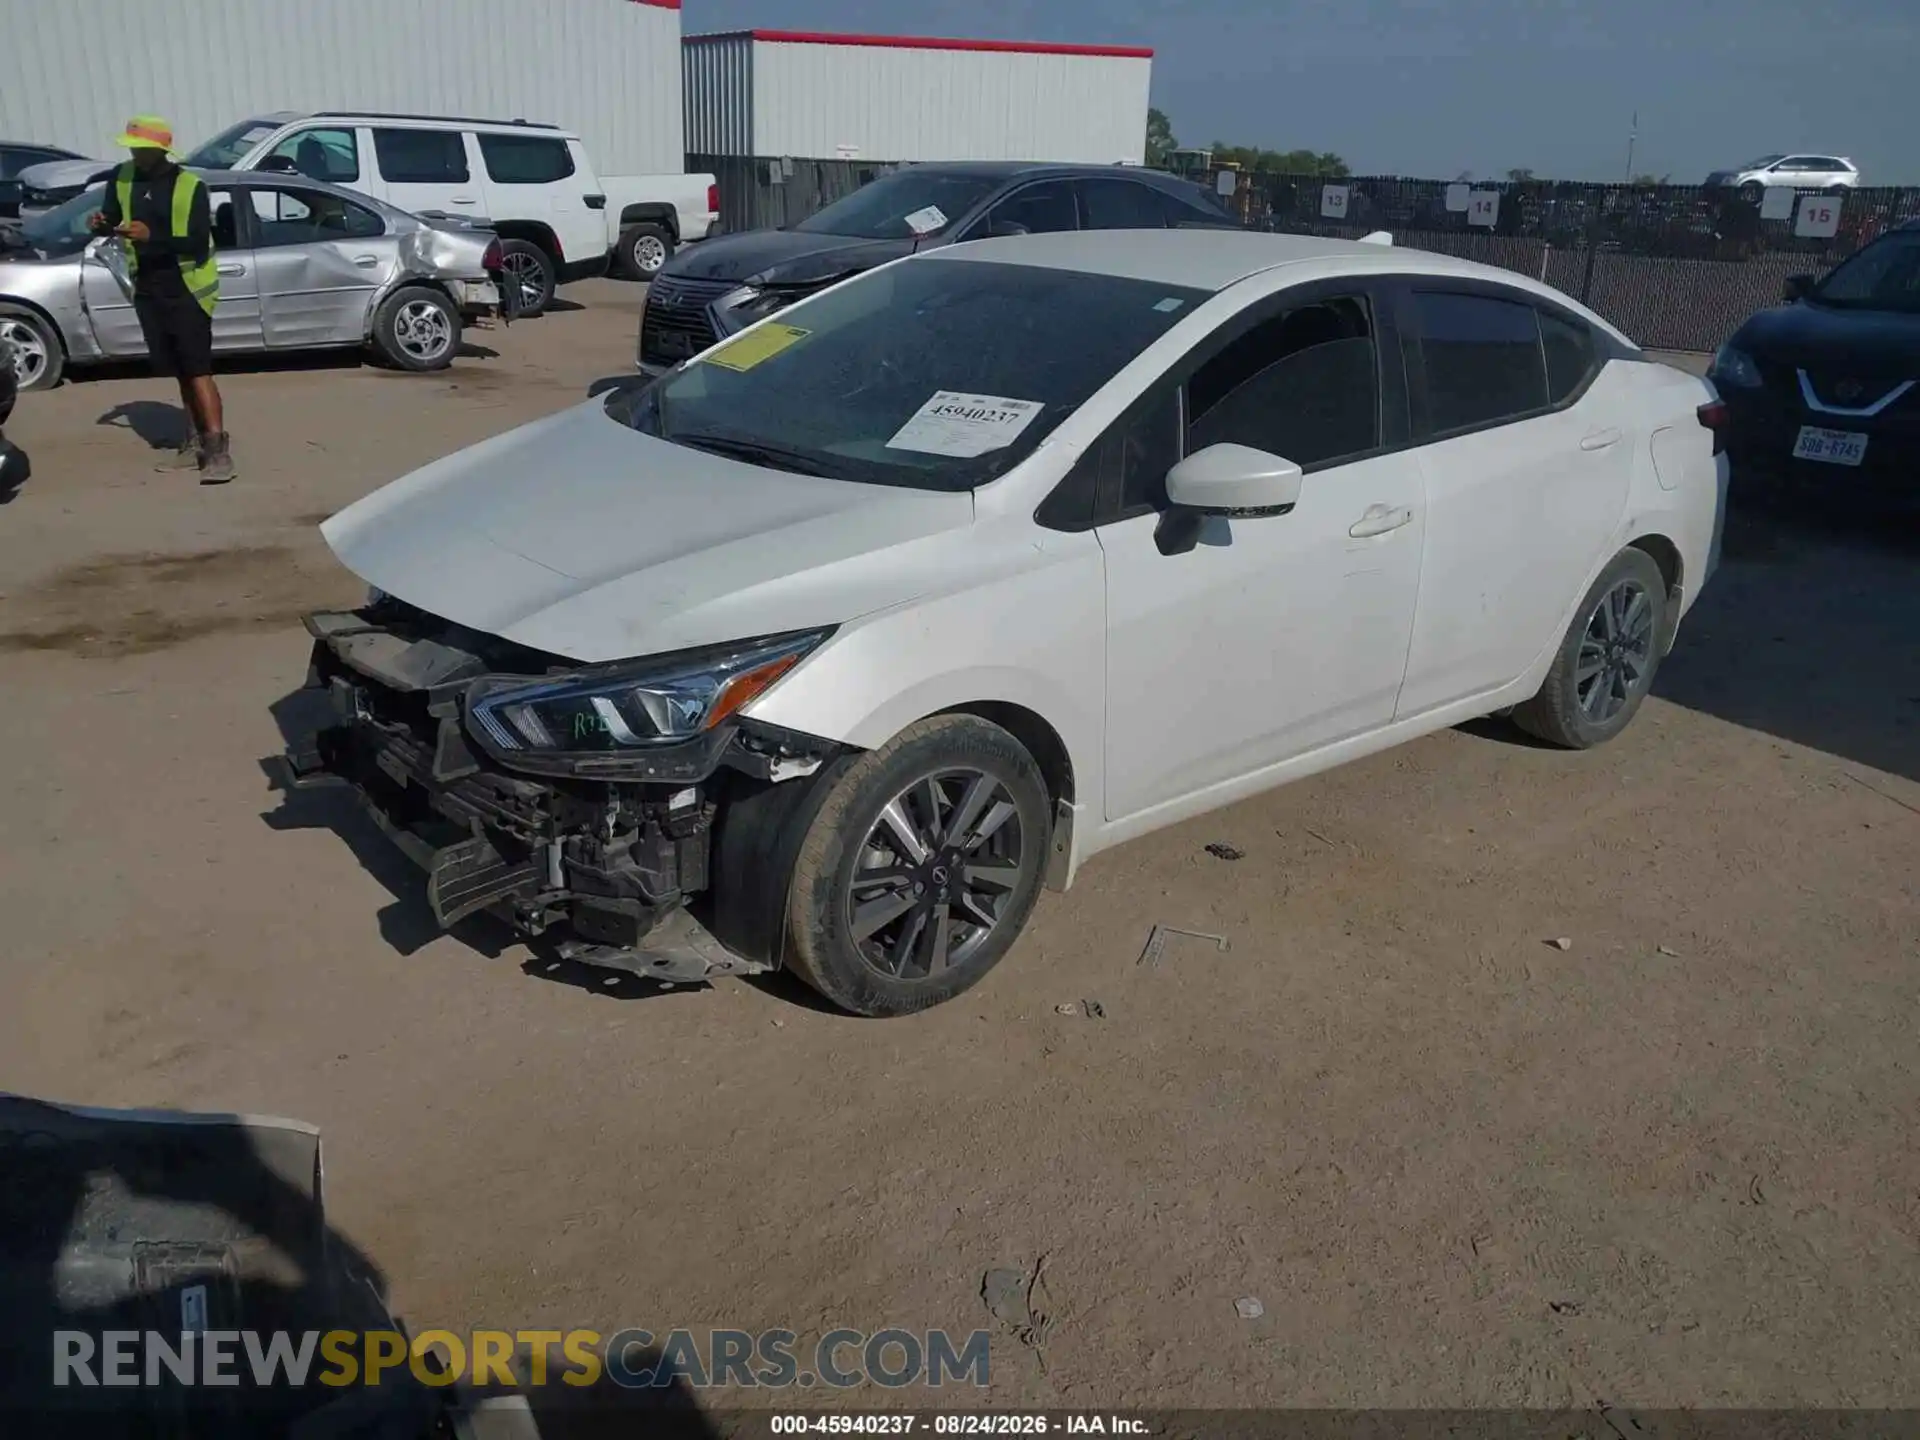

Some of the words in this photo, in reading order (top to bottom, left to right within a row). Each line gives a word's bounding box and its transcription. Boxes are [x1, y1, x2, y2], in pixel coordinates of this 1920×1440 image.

[1328, 194, 1343, 207] 13
[1475, 201, 1493, 214] 14
[1807, 208, 1832, 223] 15
[930, 404, 1020, 424] 45940237
